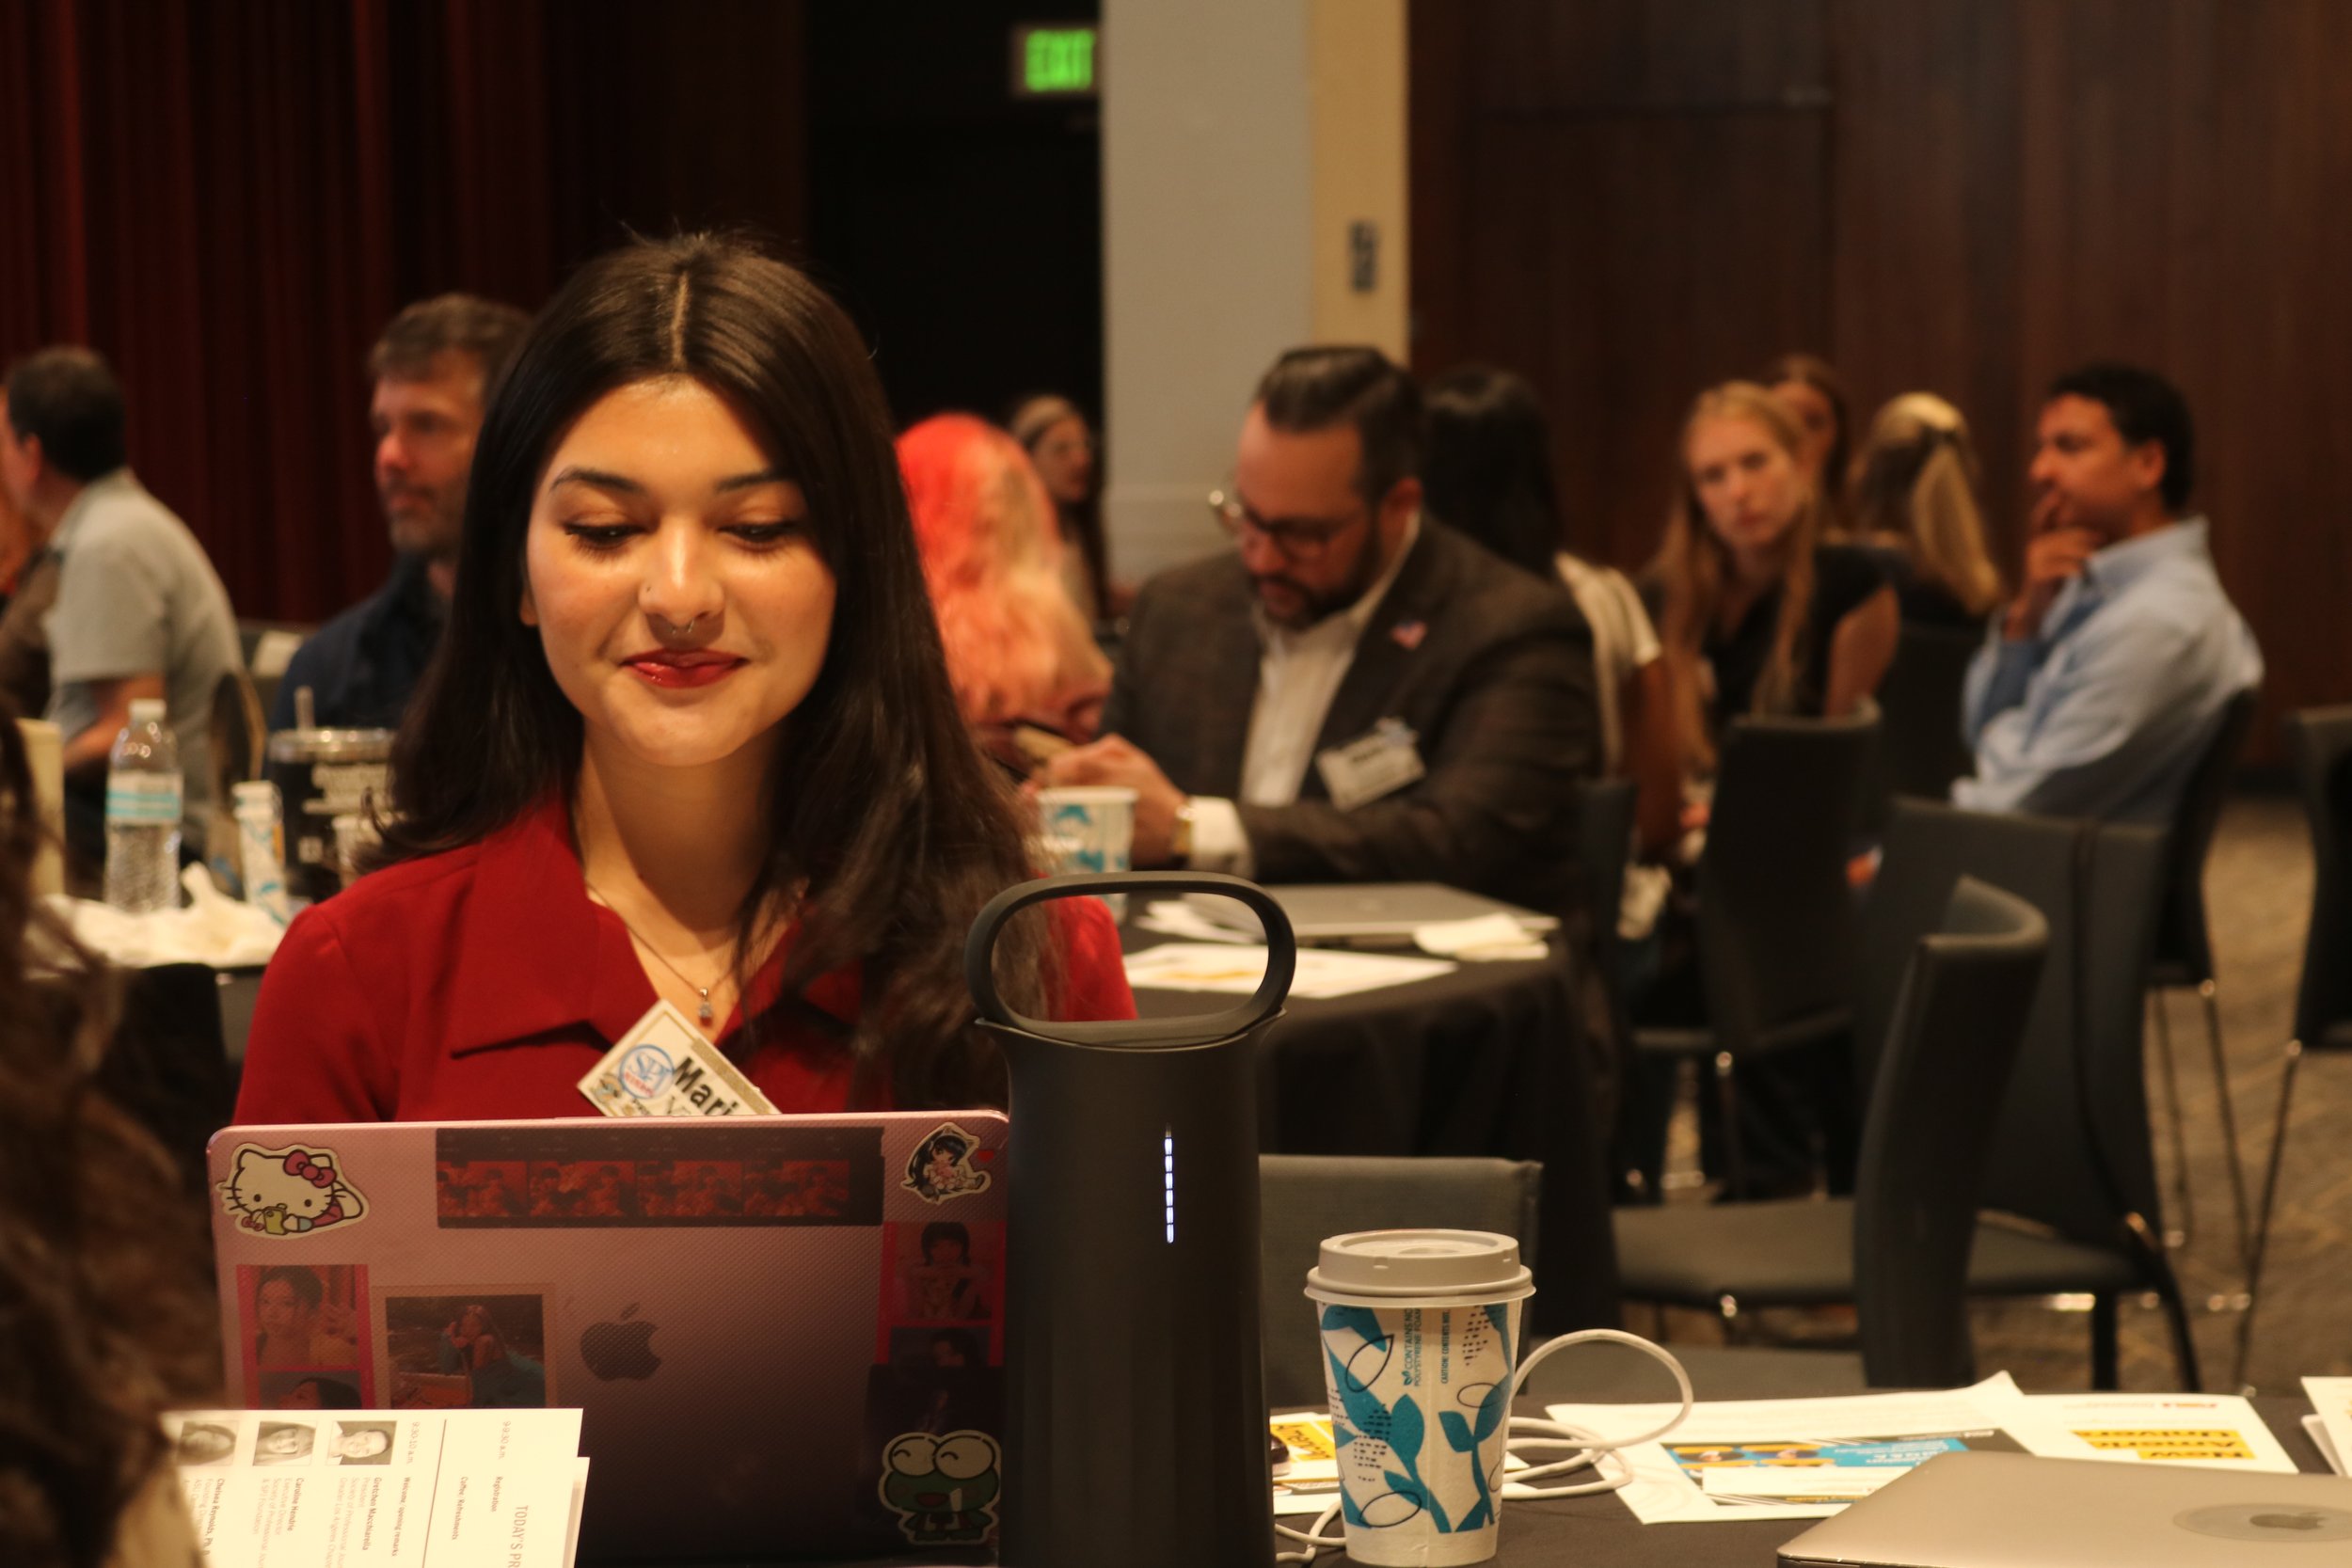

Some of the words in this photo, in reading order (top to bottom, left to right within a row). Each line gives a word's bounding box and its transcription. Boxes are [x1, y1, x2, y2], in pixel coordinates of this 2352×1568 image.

[1404, 1323, 1412, 1370] CONTAINS
[1441, 1324, 1450, 1354] CONTENTS
[213, 1478, 226, 1504] Chelsea
[291, 1477, 305, 1505] Caroline
[370, 1477, 383, 1507] Gretchen
[490, 1476, 503, 1513] Registration
[286, 1505, 300, 1532] Hendrie
[361, 1507, 377, 1552] Macchiarella
[510, 1505, 529, 1550] TODAY'S
[390, 1531, 402, 1558] remarks
